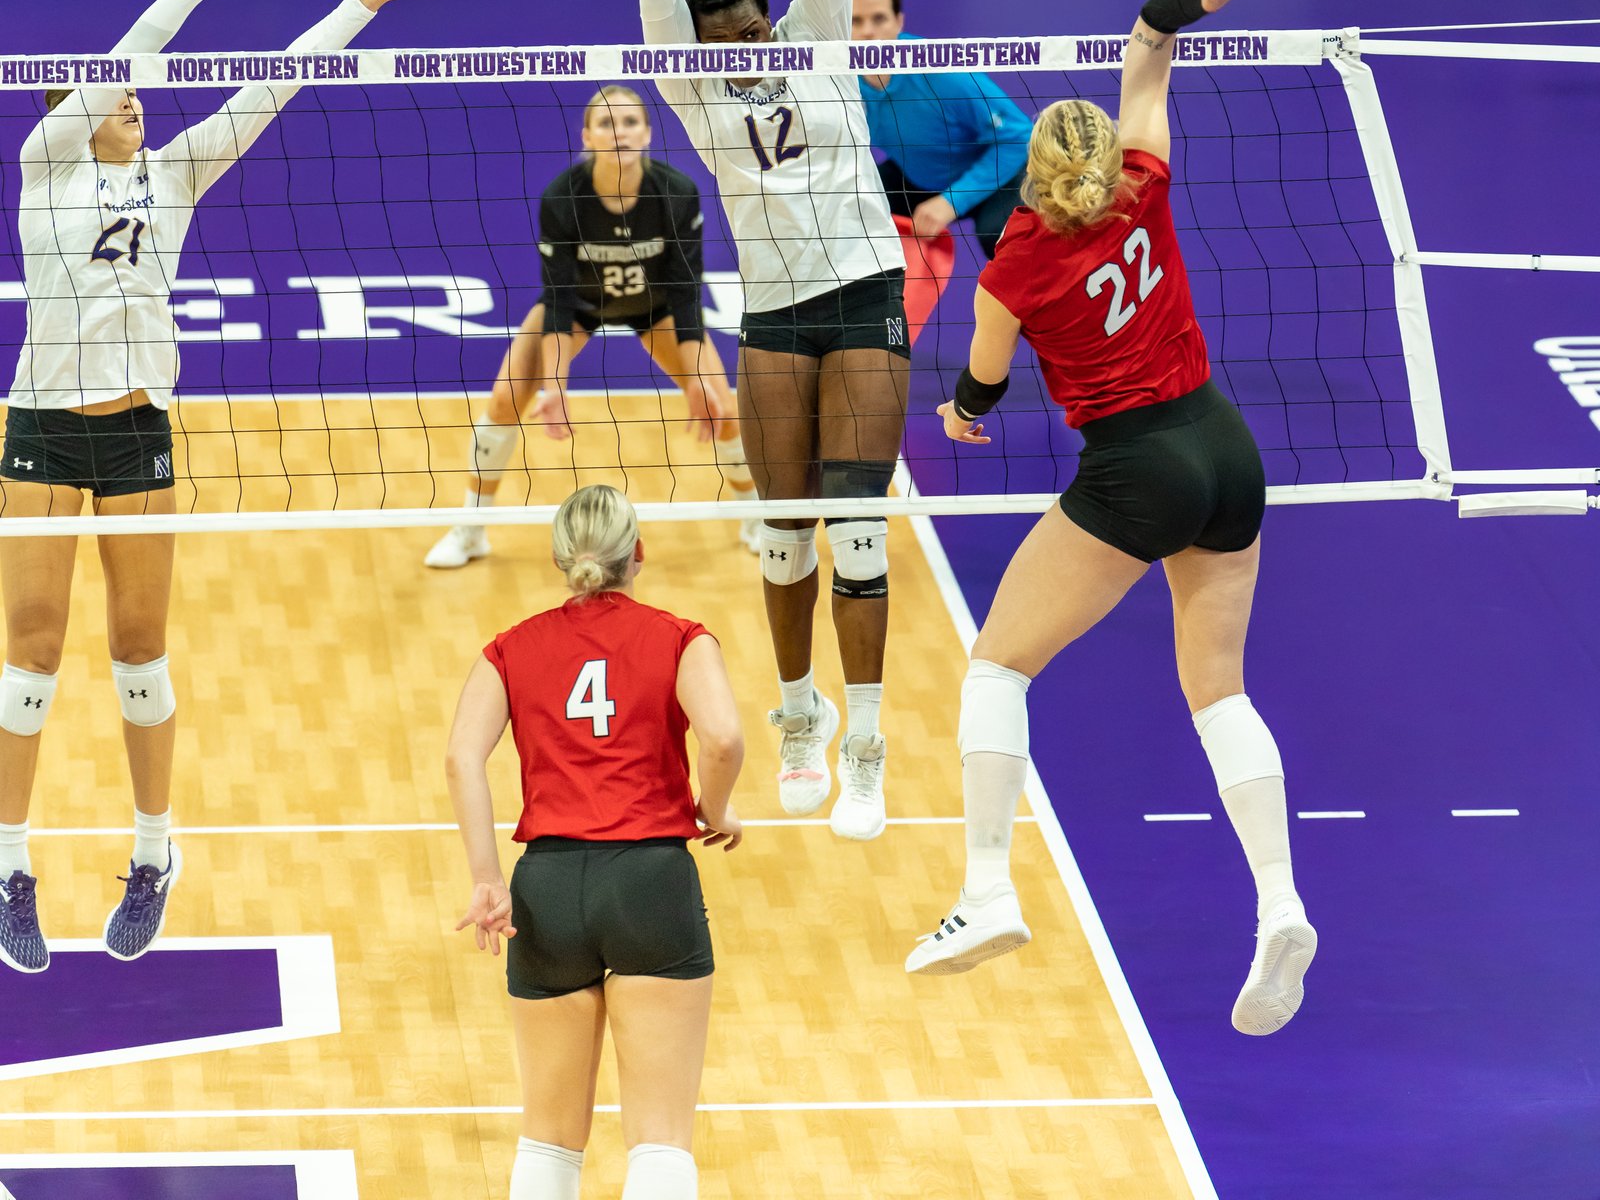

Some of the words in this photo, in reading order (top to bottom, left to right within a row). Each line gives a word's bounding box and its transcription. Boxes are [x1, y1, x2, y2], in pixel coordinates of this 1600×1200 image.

[0, 58, 131, 84] HWESTERN
[166, 54, 359, 83] NORTHWESTERN
[394, 50, 587, 78] NORTHWESTERN
[621, 46, 814, 74] NORTHWESTERN
[848, 41, 1041, 70] NORTHWESTERN
[744, 106, 809, 171] 12
[90, 217, 146, 267] 21
[603, 265, 646, 297] 23
[1084, 226, 1164, 337] 22
[886, 317, 903, 345] N
[154, 451, 170, 479] N
[565, 658, 616, 738] 4
